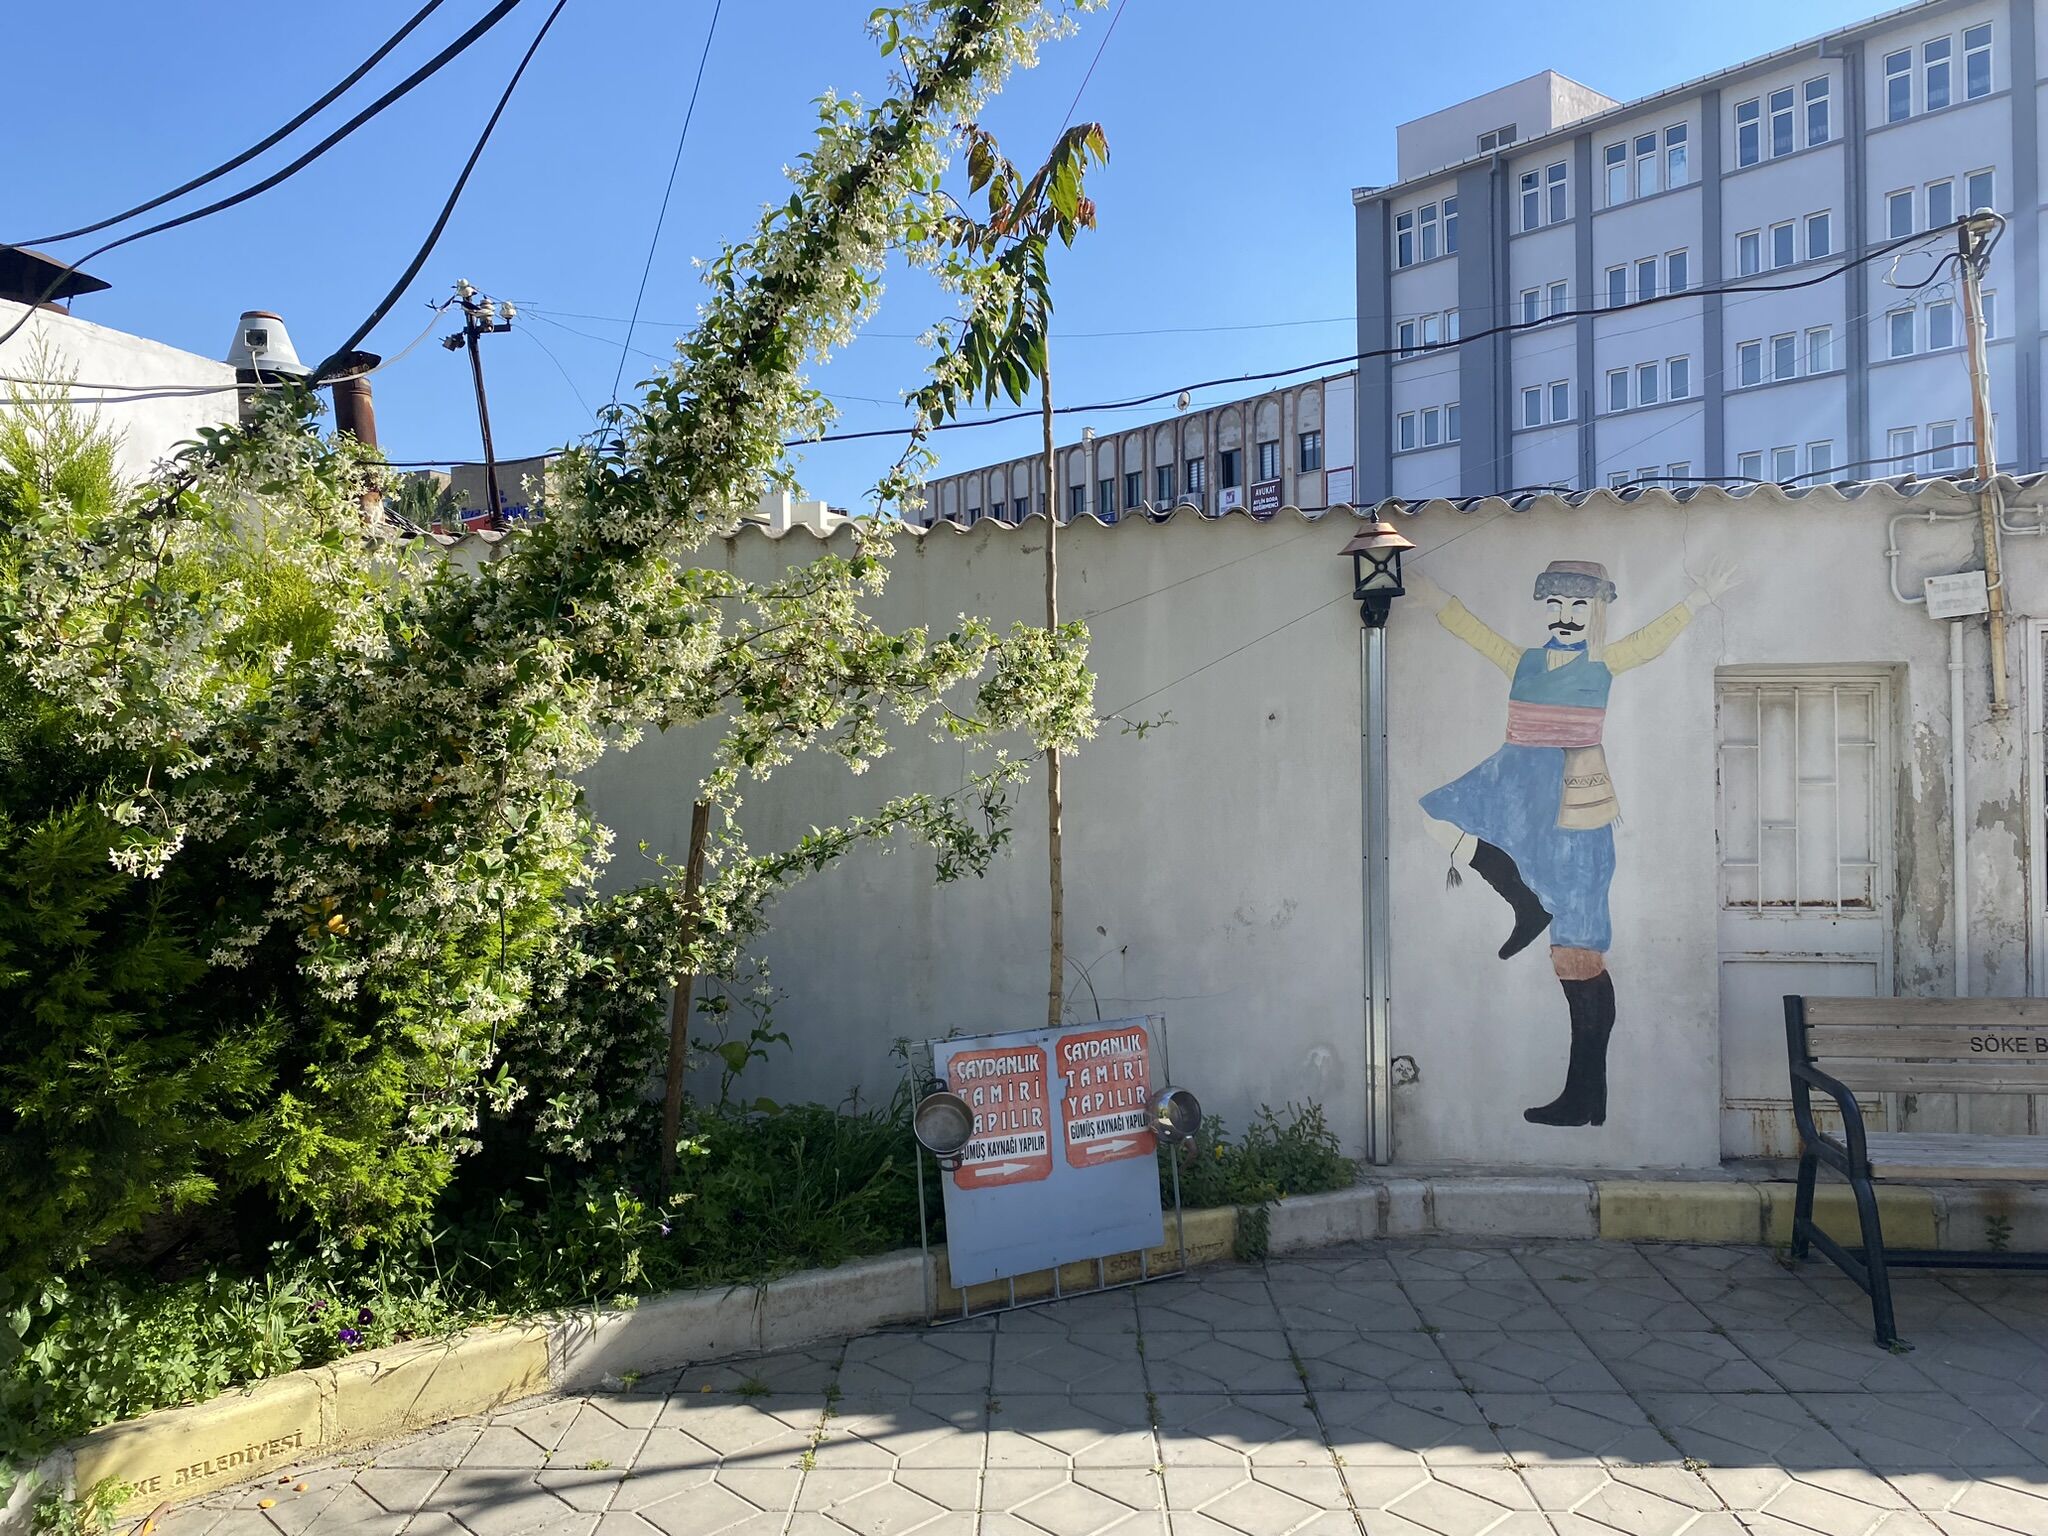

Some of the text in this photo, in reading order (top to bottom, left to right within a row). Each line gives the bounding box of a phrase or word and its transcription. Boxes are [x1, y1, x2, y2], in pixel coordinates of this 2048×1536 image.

[1255, 486, 1276, 497] AVUKAT
[1063, 1034, 1142, 1066] ÇAYDANLIK
[1970, 1034, 2029, 1053] SÖKE
[956, 1053, 1041, 1085] ÇAYDANLIK
[1065, 1055, 1144, 1088] TAMİRİ
[1068, 1086, 1147, 1117] YAPILIR
[972, 1106, 1043, 1136] APILIR
[1070, 1112, 1149, 1139] GÜMÜŞ KAYNAĞI YAPILI
[987, 1136, 1018, 1157] KAYNAĞI
[1019, 1134, 1046, 1154] YAPILIR
[174, 1429, 303, 1487] BELEDİYESİ
